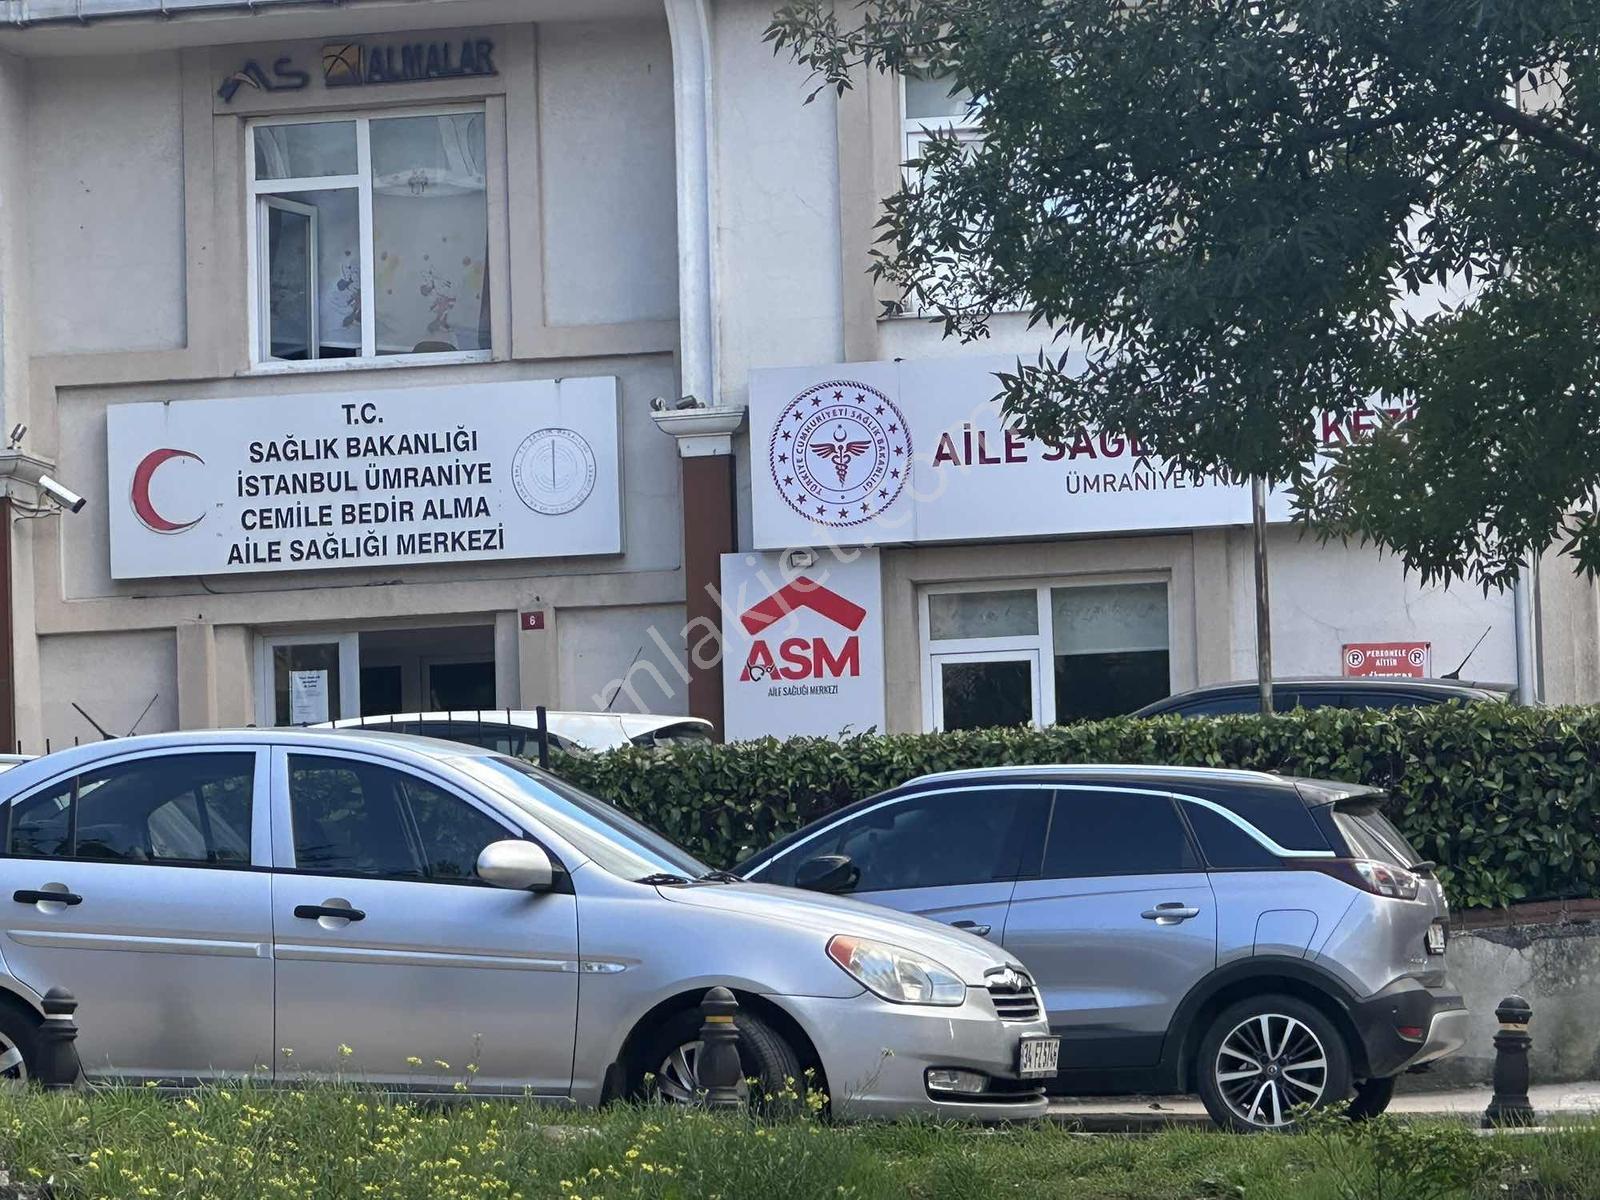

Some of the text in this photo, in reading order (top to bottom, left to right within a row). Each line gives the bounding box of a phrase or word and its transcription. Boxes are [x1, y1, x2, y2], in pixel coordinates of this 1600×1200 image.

[218, 39, 498, 102] AS ALMALAR
[341, 403, 383, 425] T.C.
[249, 425, 478, 463] SAĞLIK BAKANLIĞI
[932, 422, 1028, 467] AİLE
[237, 462, 493, 498] İSTANBUL ÜMRANİYE
[1066, 467, 1186, 495] ÜMRANİYE
[240, 495, 490, 530] CEMİLE BEDİR ALMA
[227, 522, 505, 566] AİLE SAĞLIĞI MERKEZİ
[529, 615, 536, 626] 6
[739, 635, 860, 682] ASM
